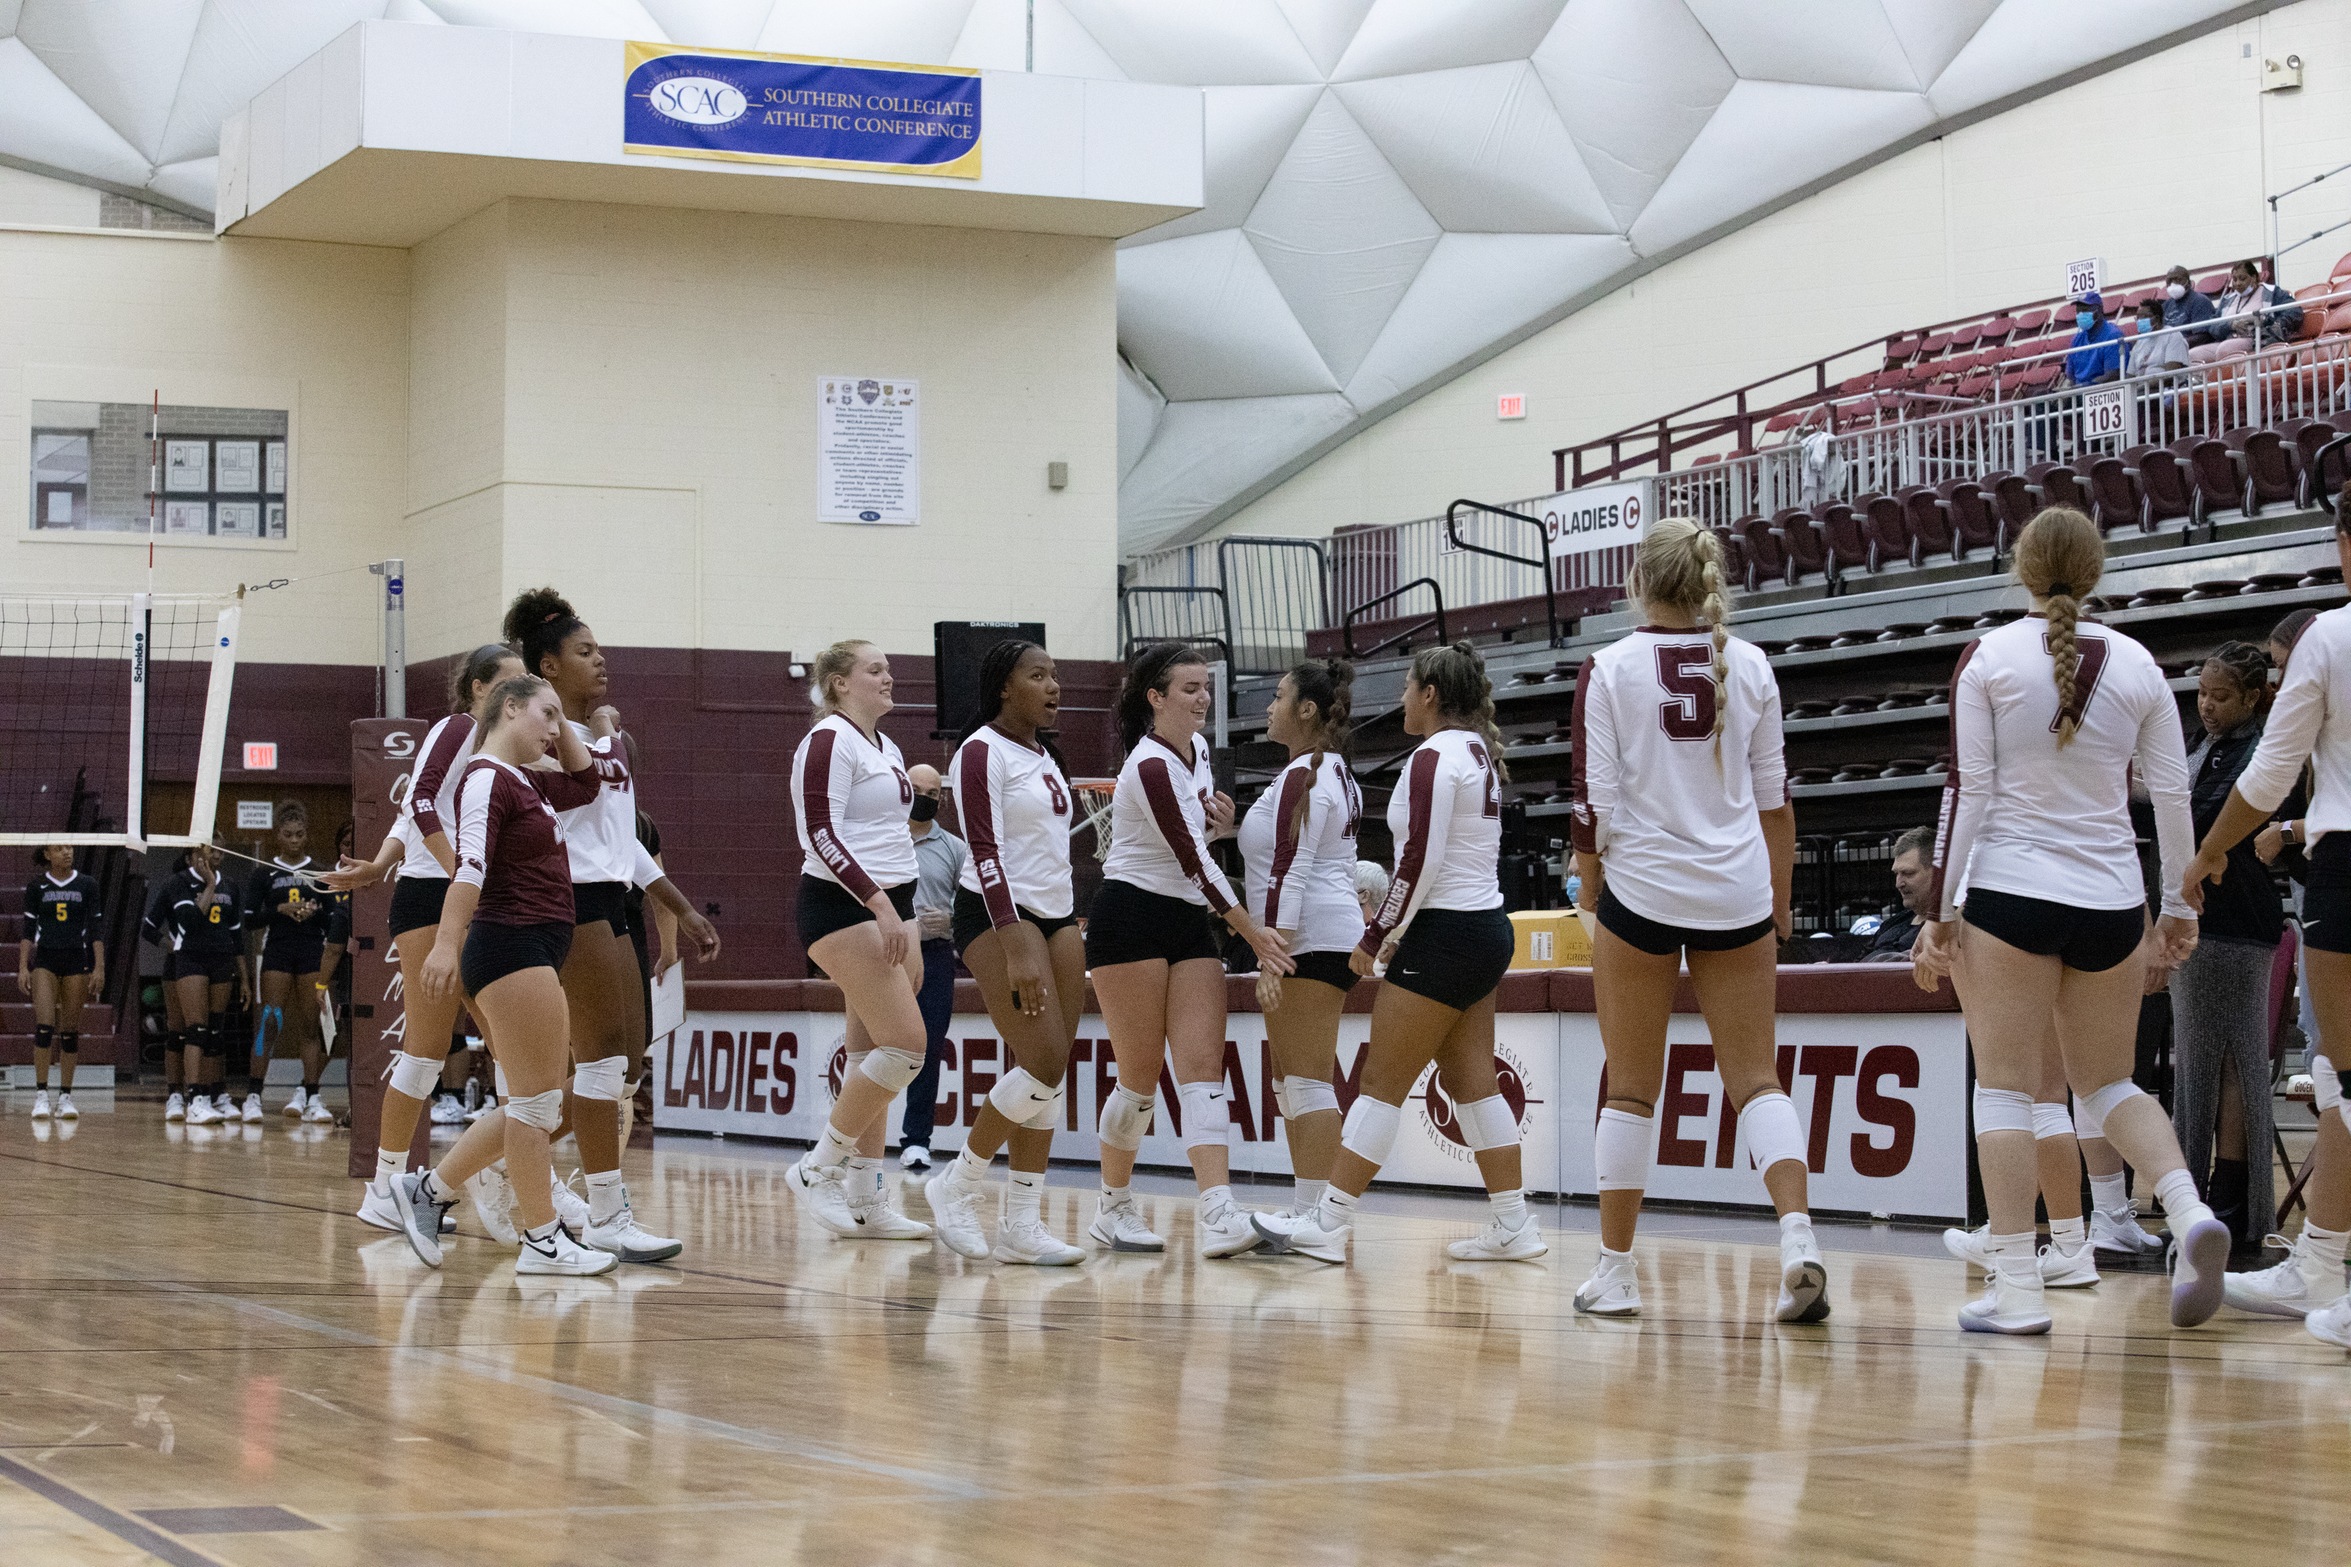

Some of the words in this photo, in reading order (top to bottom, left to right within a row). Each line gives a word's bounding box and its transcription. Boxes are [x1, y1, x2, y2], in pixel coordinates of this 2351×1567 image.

[643, 69, 693, 93] SOUTHERN
[697, 69, 754, 100] COLLEGIATE
[659, 83, 737, 118] SCAC
[763, 87, 862, 109] SOUTHERN
[866, 95, 974, 117] COLLEGIATE
[644, 102, 688, 129] ATHLETIC
[692, 111, 753, 132] CONFERENCE
[762, 110, 851, 131] ATHLETIC
[854, 116, 973, 140] CONFERENCE
[2070, 262, 2094, 273] SECTION
[2071, 271, 2095, 293] 205
[1501, 397, 1521, 416] EXIT
[2088, 391, 2120, 407] SECTION
[2089, 404, 2122, 432] 103
[1562, 504, 1618, 536] LADIES
[134, 642, 144, 683] Schelde
[1654, 643, 1718, 741] 5
[2042, 632, 2110, 733] 7
[250, 746, 273, 767] EXIT
[889, 764, 912, 805] 6
[1042, 772, 1069, 817] 8
[1467, 740, 1502, 820] 2
[1931, 786, 1955, 869] CENTENARY
[56, 902, 68, 922] 5
[209, 905, 222, 924] 6
[664, 1029, 798, 1116] LADIES
[1595, 1044, 1920, 1178] ENTS
[1418, 1109, 1464, 1162] ATHLETIC
